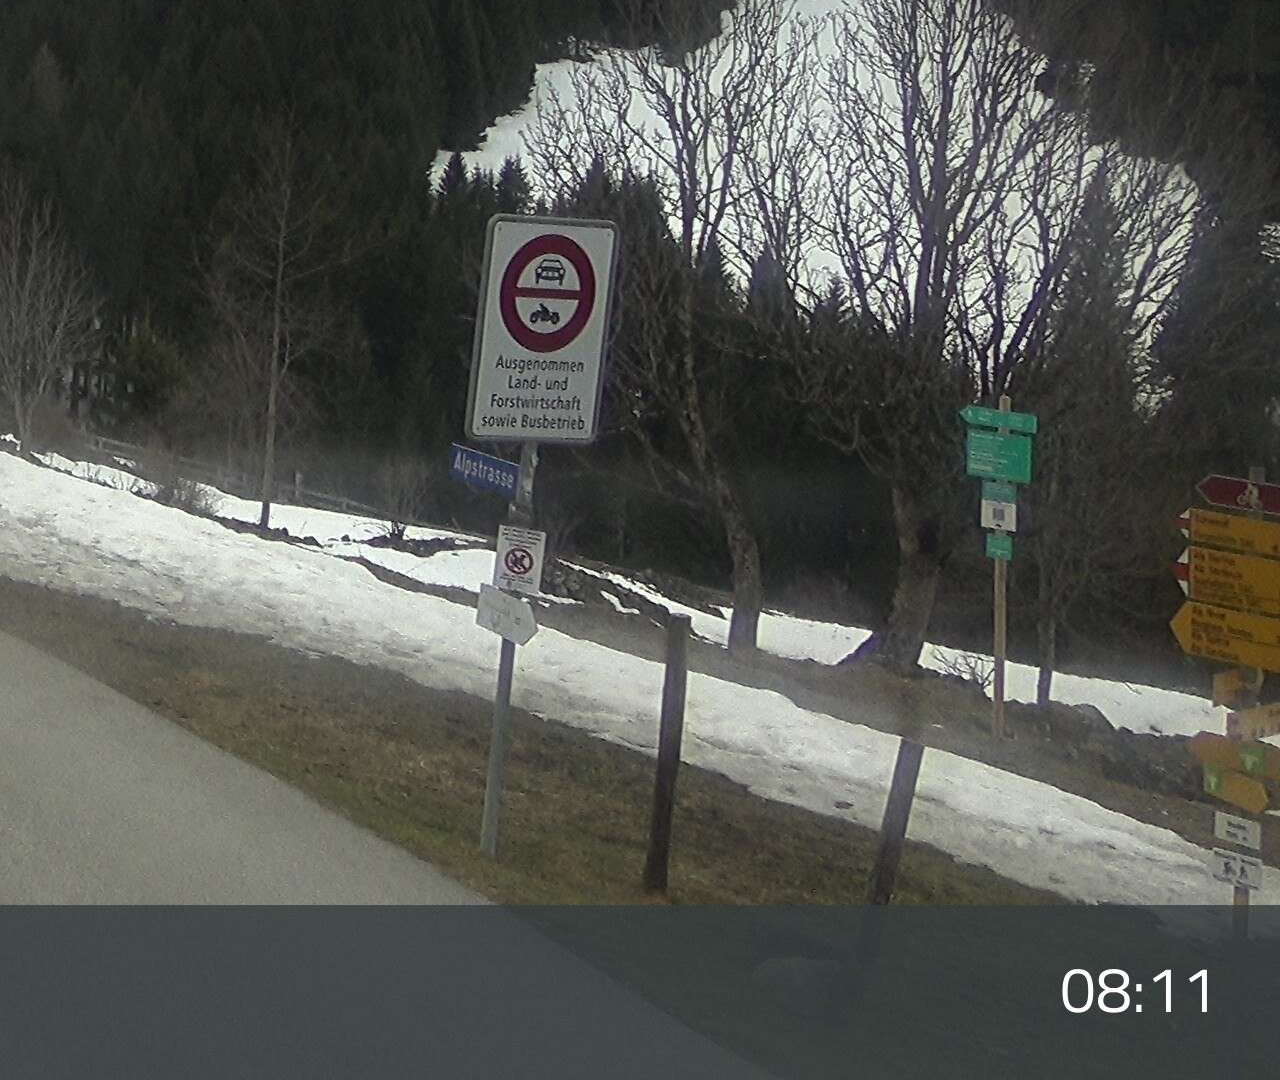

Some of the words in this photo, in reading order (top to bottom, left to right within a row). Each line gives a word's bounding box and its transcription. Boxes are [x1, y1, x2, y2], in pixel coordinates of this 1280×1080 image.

[495, 354, 585, 374] Ausgenommen
[508, 375, 541, 390] Land-
[545, 376, 569, 391] und
[490, 393, 581, 411] Forstwirtschaft
[480, 413, 517, 428] sowie
[521, 414, 585, 430] Busbetrieb
[453, 450, 515, 489] Alpstrasse
